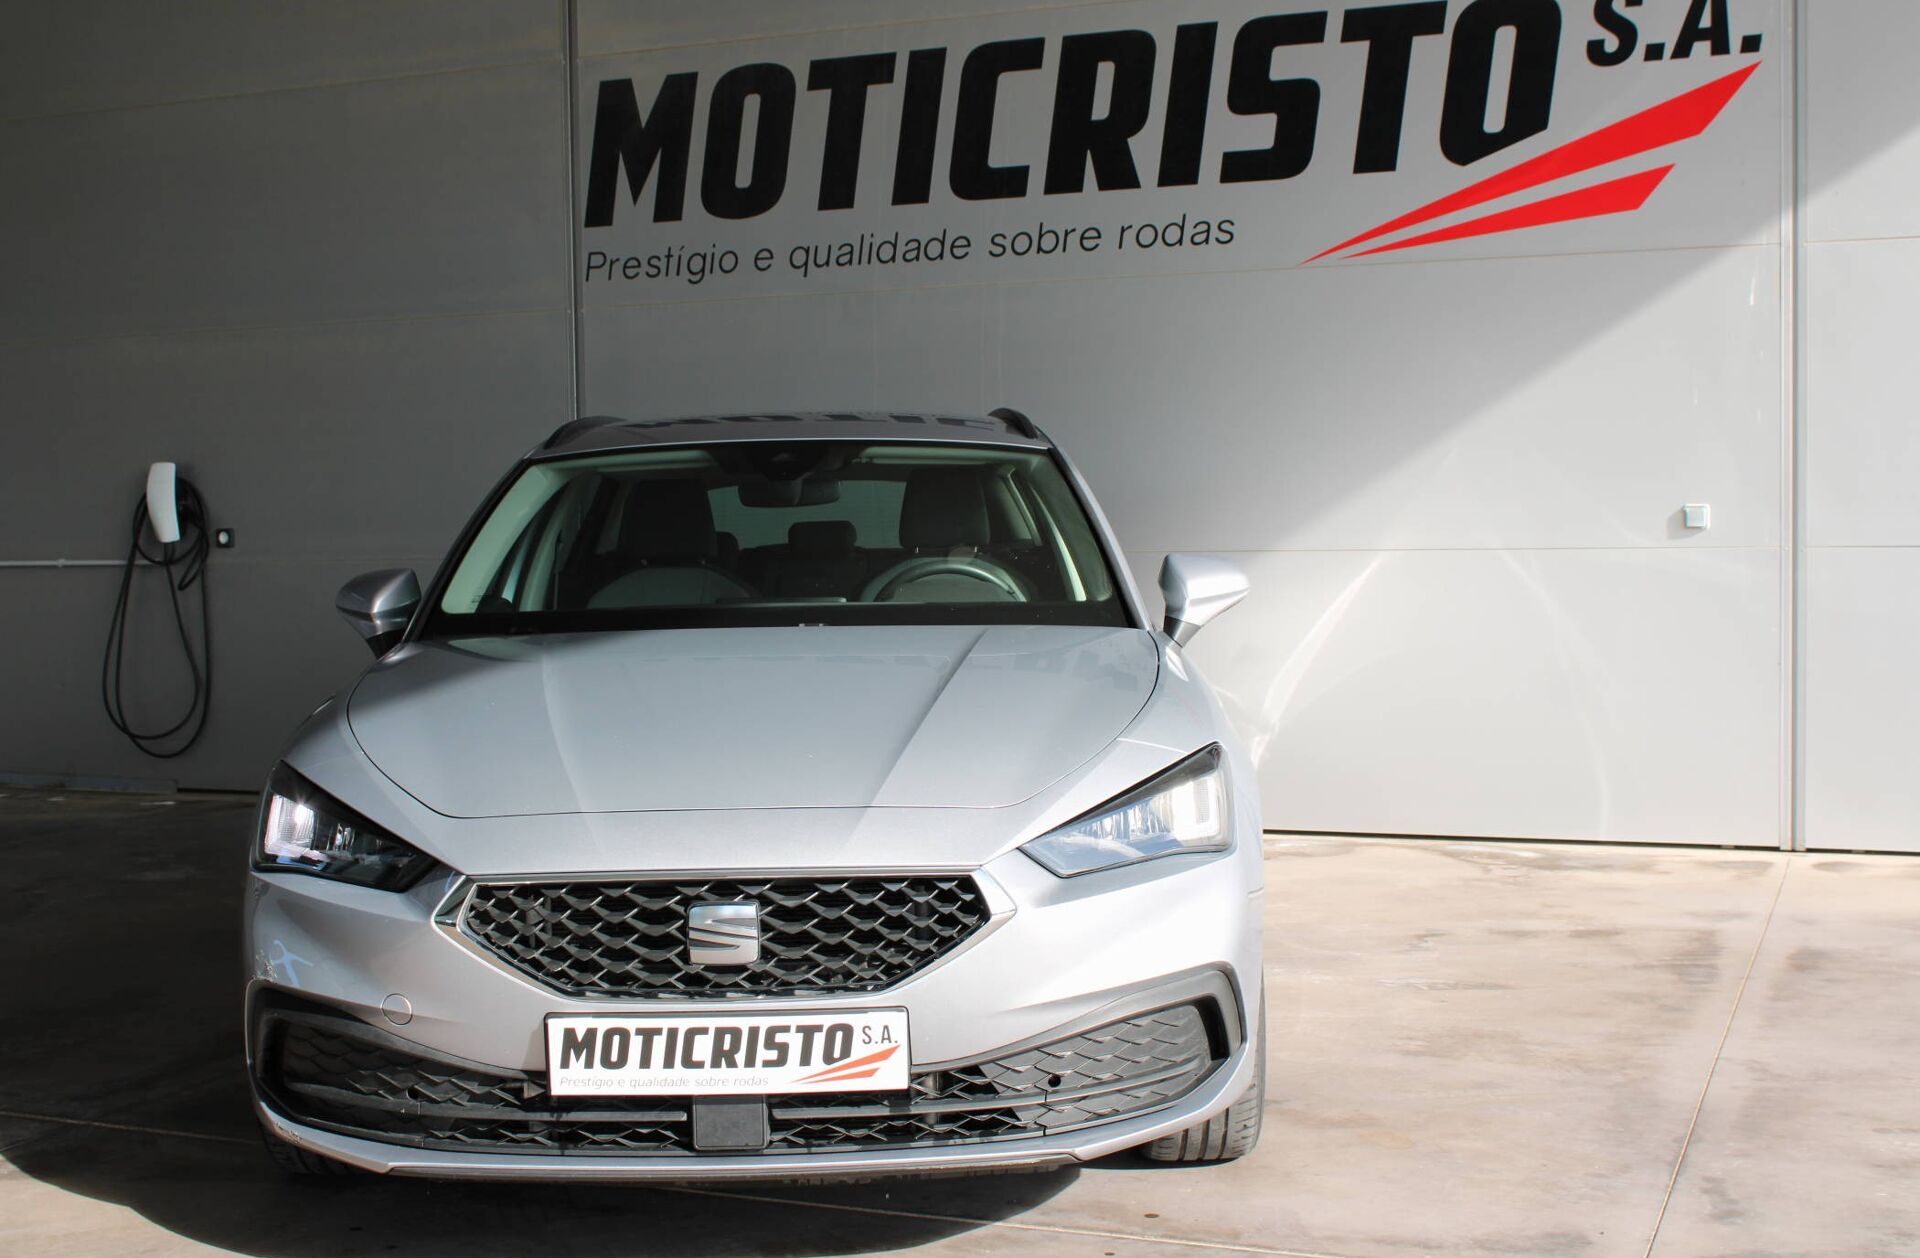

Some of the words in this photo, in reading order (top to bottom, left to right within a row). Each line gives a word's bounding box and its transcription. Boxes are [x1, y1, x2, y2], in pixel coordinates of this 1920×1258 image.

[584, 0, 1562, 228] MOTICRISTO
[1586, 0, 1763, 67] S.A.
[585, 245, 739, 285] Prestígio
[753, 250, 774, 271] e
[789, 228, 971, 278] qualidade
[988, 222, 1102, 258] sobre
[1117, 213, 1235, 250] rodas
[560, 1023, 854, 1069] MOTICRISTO
[862, 1025, 899, 1045] S.A.
[629, 1076, 690, 1089] qualidade
[694, 1076, 729, 1087] sobre
[733, 1075, 769, 1087] rodas
